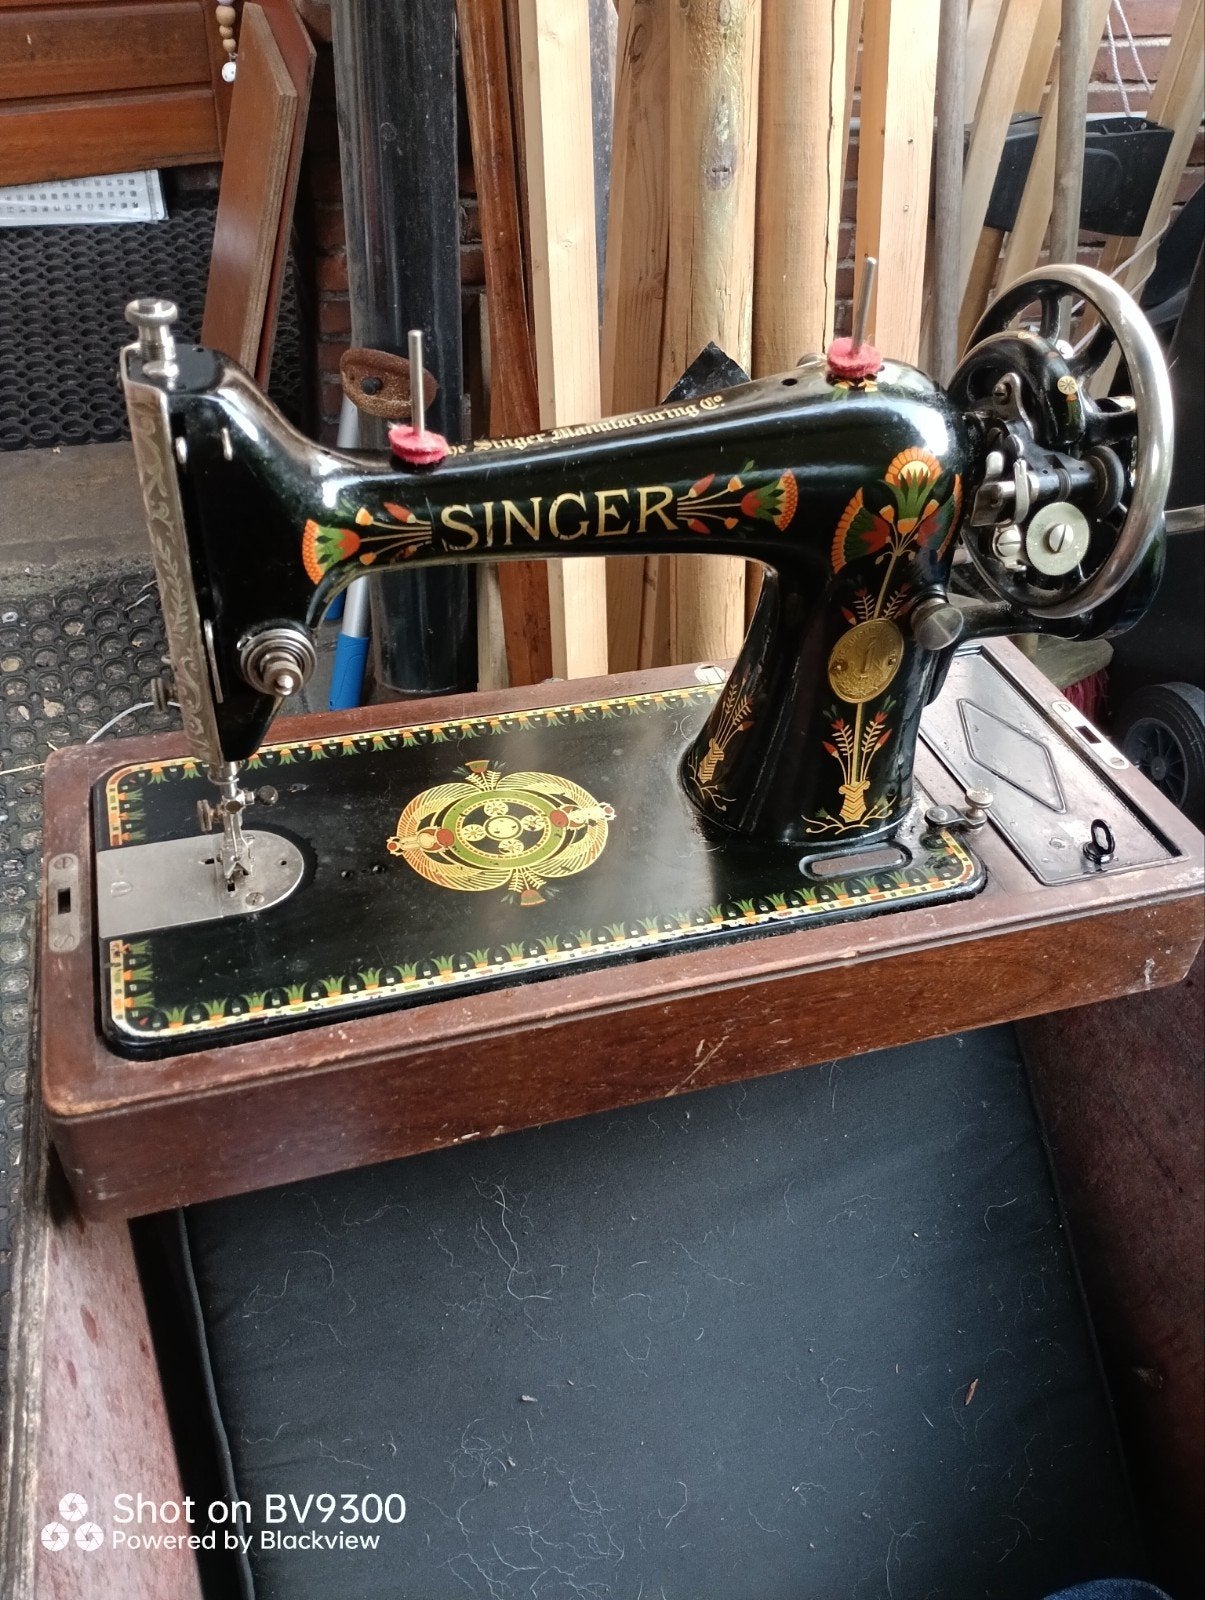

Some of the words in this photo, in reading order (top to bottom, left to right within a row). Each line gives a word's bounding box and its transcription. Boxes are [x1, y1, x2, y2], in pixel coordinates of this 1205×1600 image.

[449, 443, 468, 458] he
[473, 432, 546, 451] Singer
[551, 403, 700, 444] Manufacturing
[440, 485, 679, 552] SINGER
